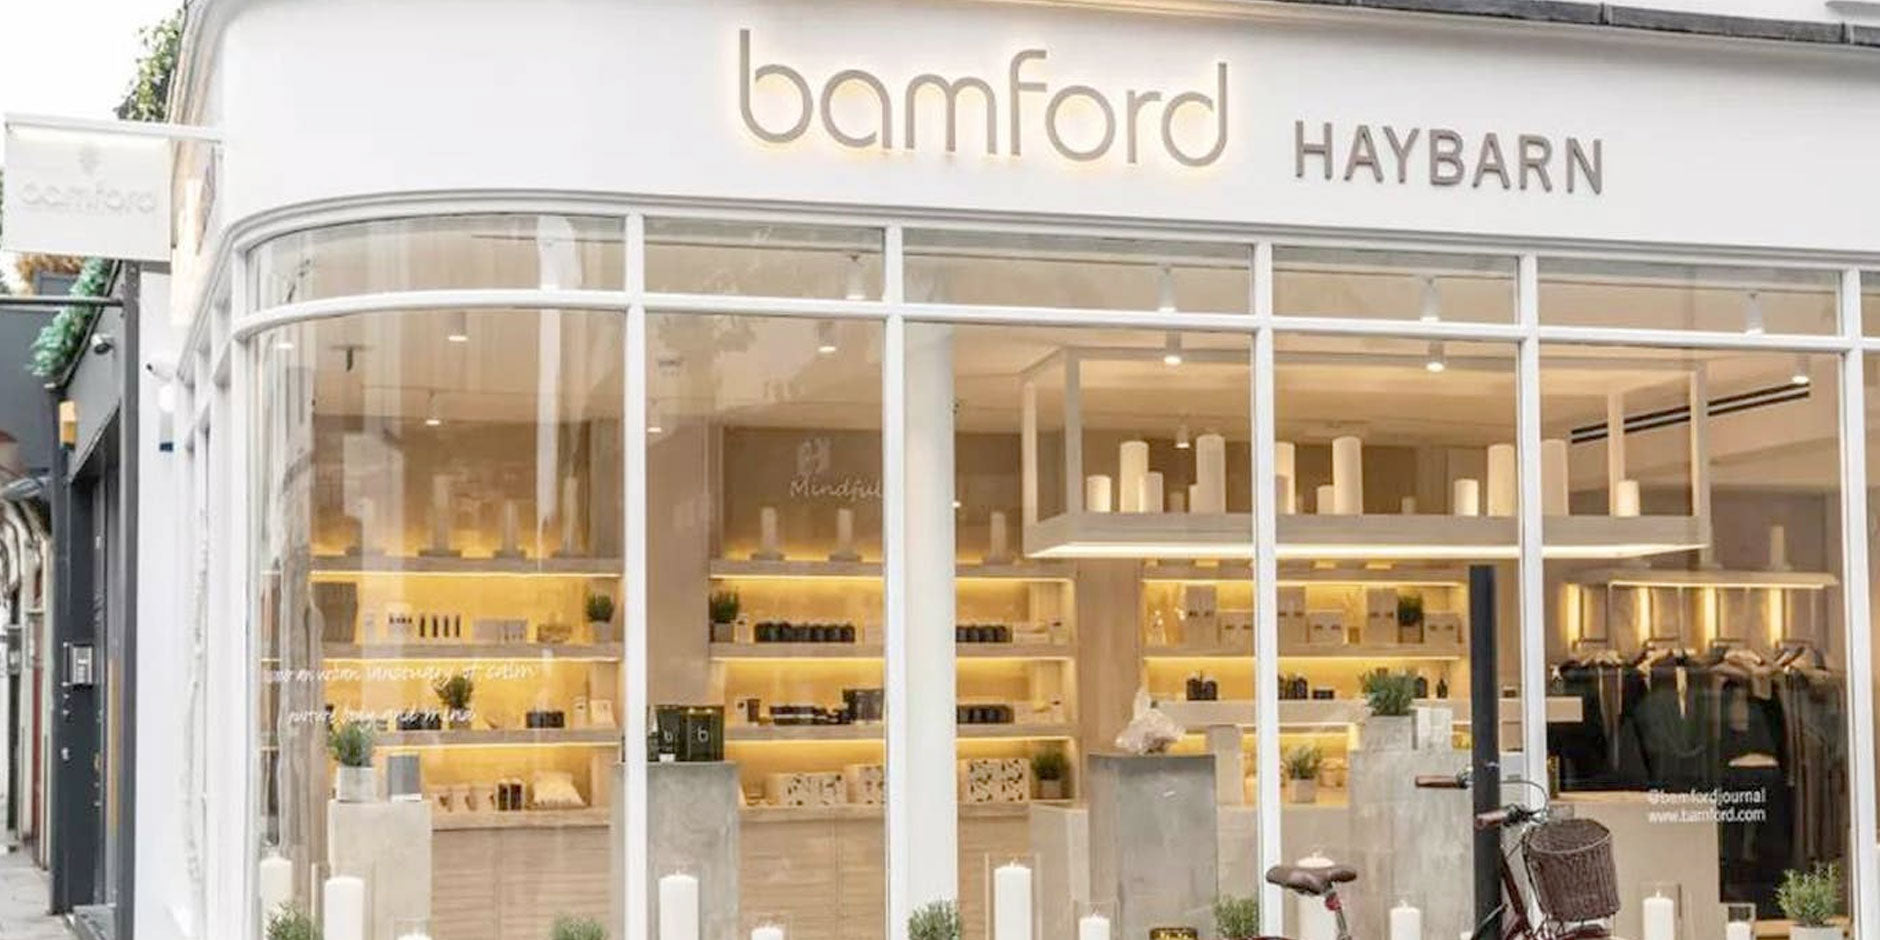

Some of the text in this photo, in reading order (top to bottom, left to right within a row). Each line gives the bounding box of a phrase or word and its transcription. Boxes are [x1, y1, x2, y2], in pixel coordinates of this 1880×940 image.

[739, 29, 1228, 168] bamford
[1294, 120, 1603, 195] HAYBARN
[789, 474, 882, 502] Mindful
[1648, 786, 1767, 806] @bamfordjournal
[1648, 806, 1767, 824] www.bamford.com
